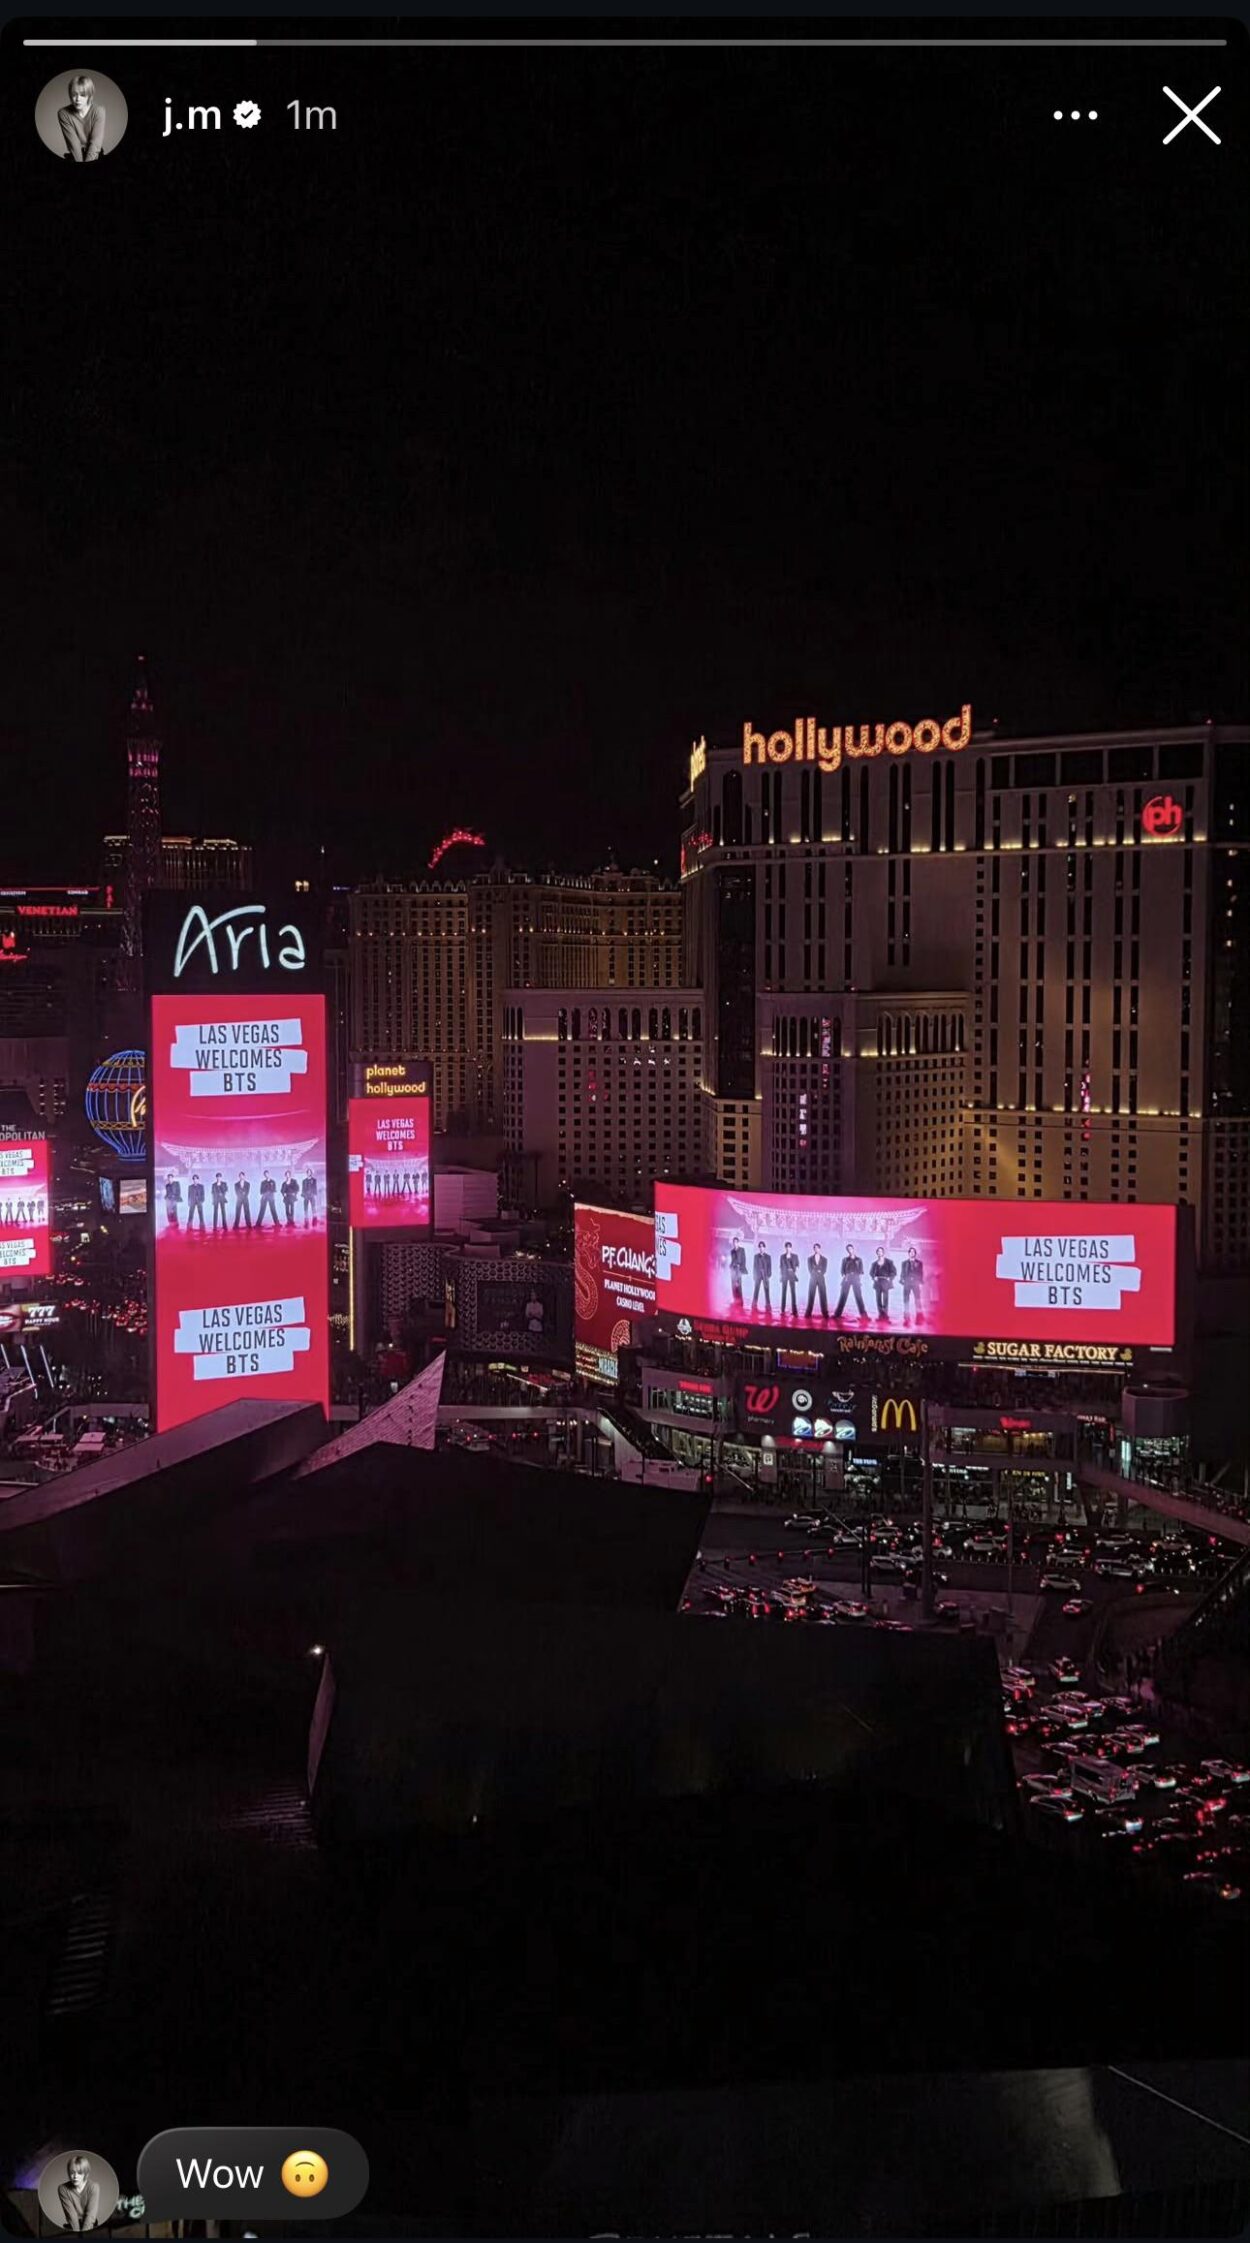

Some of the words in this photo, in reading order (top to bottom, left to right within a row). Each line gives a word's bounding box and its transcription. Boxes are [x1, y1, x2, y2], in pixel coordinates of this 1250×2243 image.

[743, 703, 972, 772] hollywood
[16, 905, 79, 917] VENETIAN
[173, 905, 305, 977] Aria
[199, 1024, 227, 1045] LAS
[231, 1023, 280, 1044] VEGAS
[195, 1048, 282, 1069] WELCOMES
[223, 1072, 256, 1092] BTS
[366, 1064, 406, 1080] planet
[366, 1081, 426, 1096] hollywood
[377, 1119, 390, 1129] LAS
[391, 1118, 414, 1129] VEGAS
[376, 1129, 415, 1140] WELCOMES
[387, 1140, 403, 1151] BTS
[1024, 1238, 1053, 1257] LAS
[1057, 1239, 1110, 1259] VEGAS
[1021, 1262, 1112, 1283] WELCOMES
[1048, 1286, 1082, 1305] BTS
[28, 1305, 56, 1317] 777
[202, 1307, 230, 1328] LAS
[235, 1304, 283, 1326] VEGAS
[199, 1328, 285, 1353] WELCOMES
[836, 1334, 896, 1355] Rainforest
[986, 1341, 1040, 1358] SUGAR
[1044, 1342, 1119, 1361] FACTORY
[226, 1353, 259, 1374] BTS
